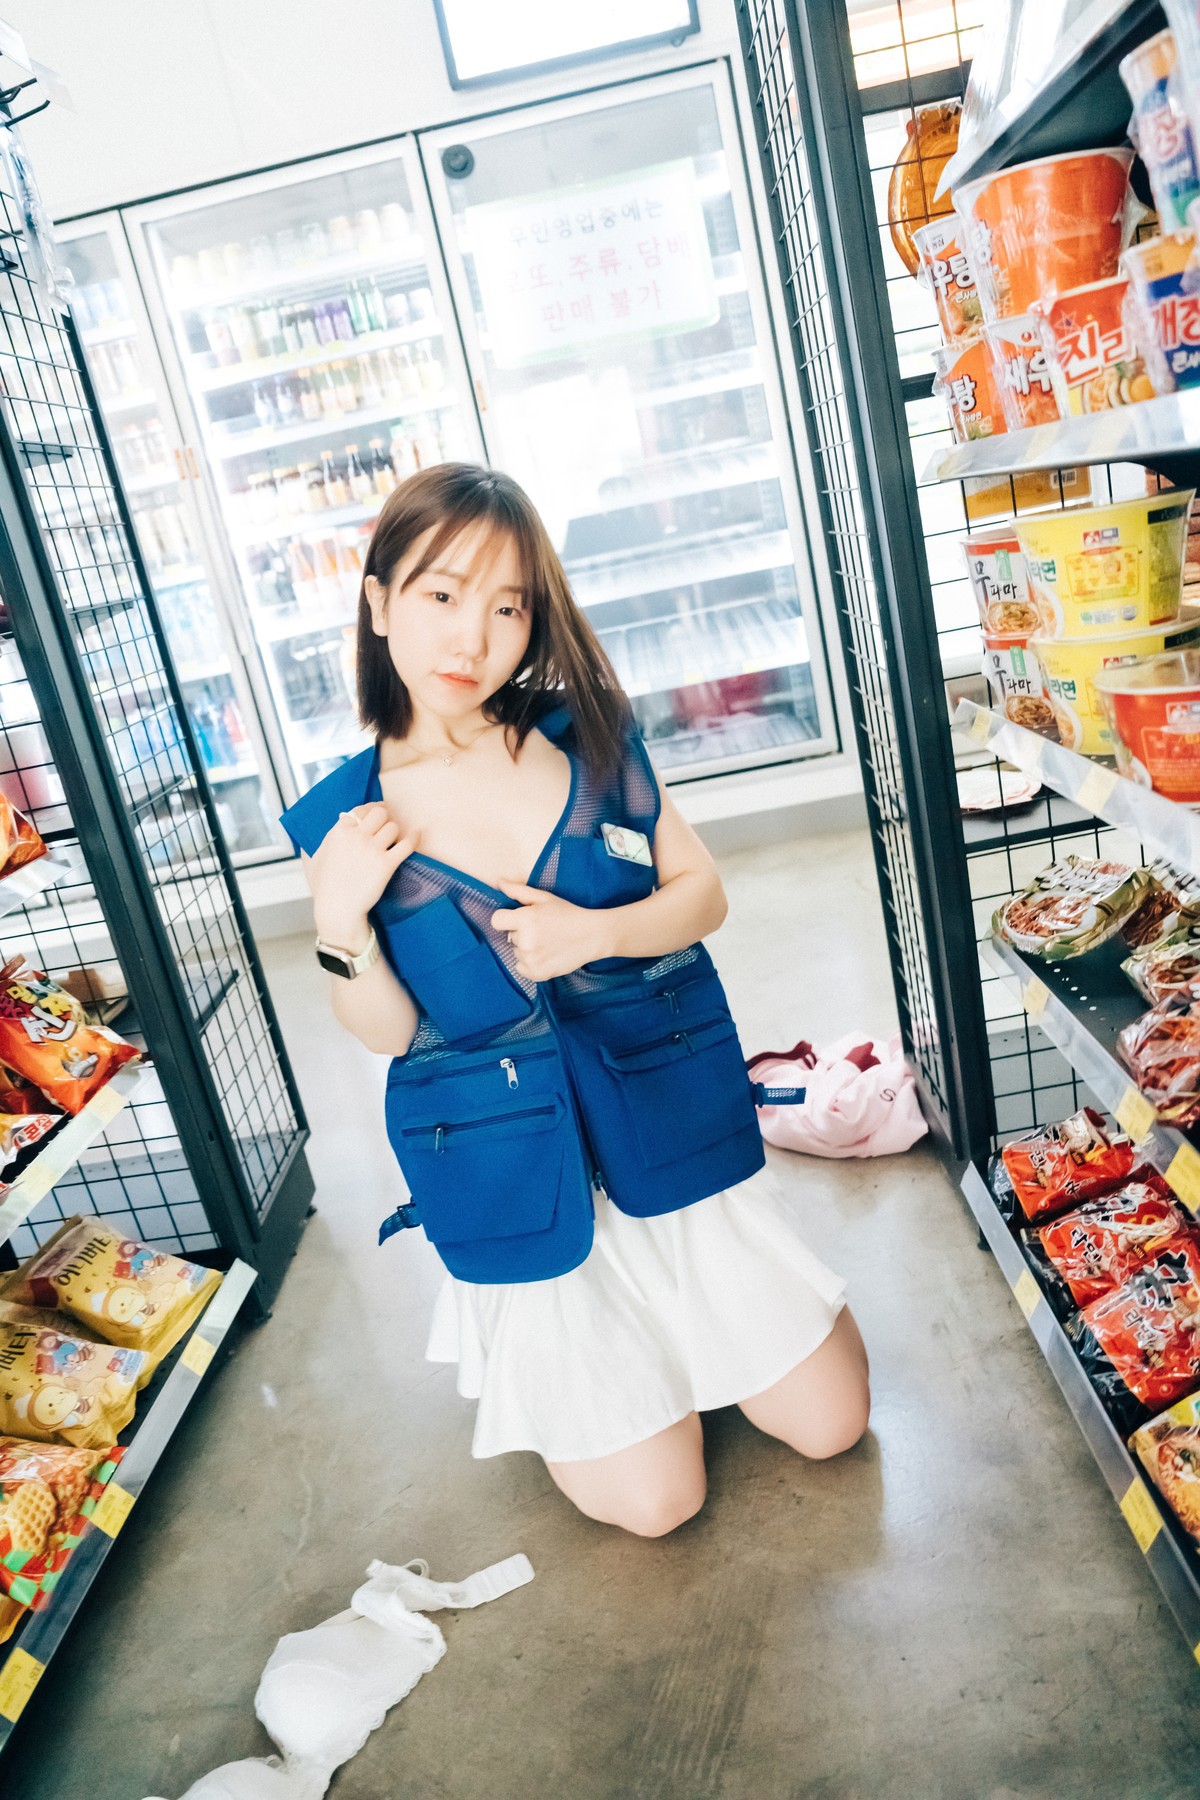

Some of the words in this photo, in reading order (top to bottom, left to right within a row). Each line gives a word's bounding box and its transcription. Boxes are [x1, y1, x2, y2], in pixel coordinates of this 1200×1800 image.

[509, 198, 663, 248] 무인영업중에는
[542, 293, 595, 333] 판매
[610, 279, 661, 318] 불가
